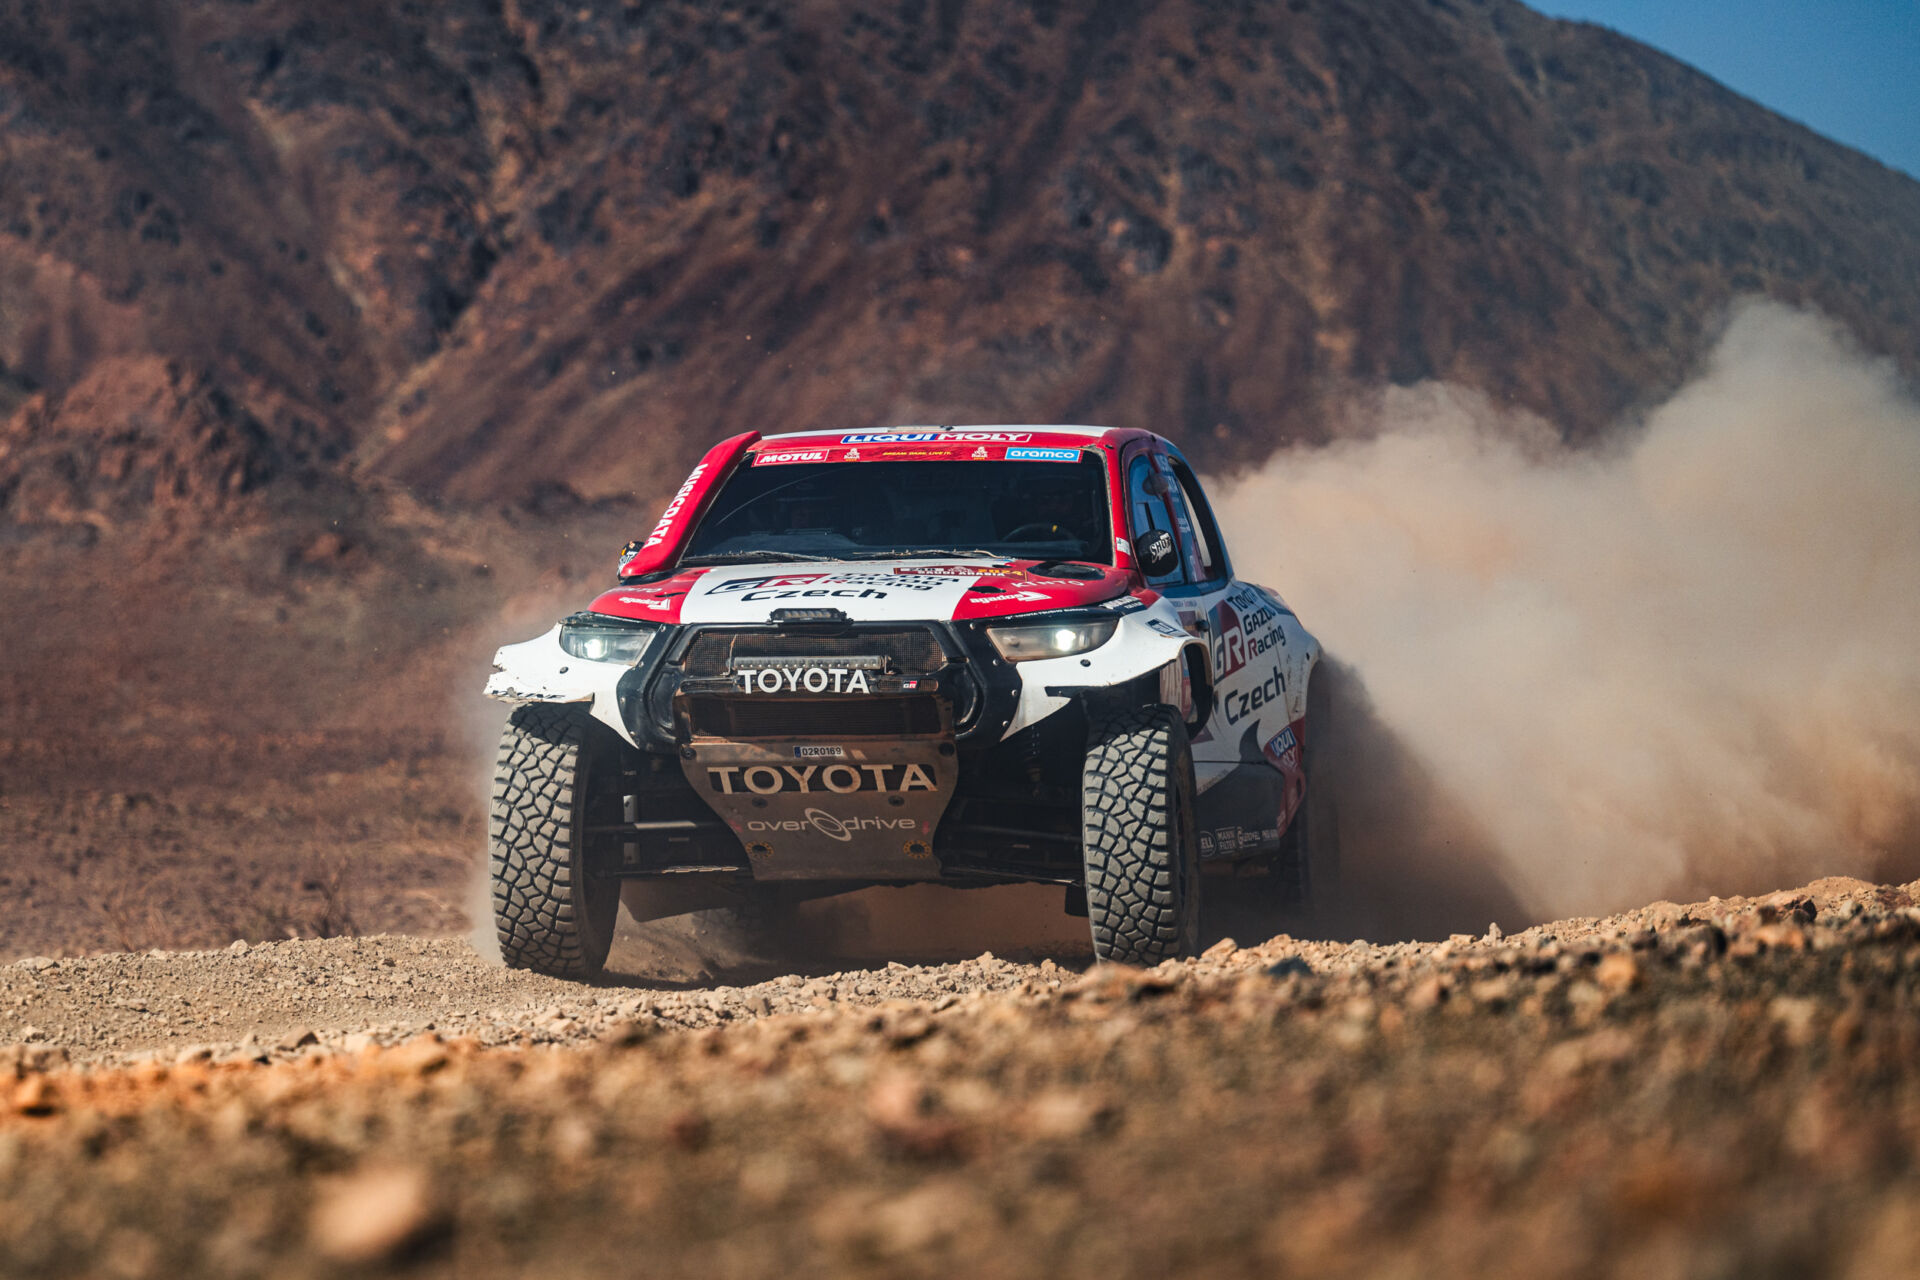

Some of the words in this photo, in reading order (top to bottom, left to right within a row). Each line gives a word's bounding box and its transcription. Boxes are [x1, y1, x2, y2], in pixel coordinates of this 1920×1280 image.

[848, 433, 934, 443] LIQUI
[937, 433, 1025, 441] MOLY
[759, 452, 823, 463] MOTUL
[1010, 450, 1075, 459] aramco
[643, 463, 709, 549] MUSICDATA
[741, 588, 888, 602] Czech
[1213, 624, 1245, 683] GR
[1247, 625, 1286, 660] Racing
[738, 668, 870, 694] TOYOTA
[1224, 665, 1286, 726] Czech
[707, 764, 938, 795] TOYOTA
[1200, 836, 1214, 849] ELL
